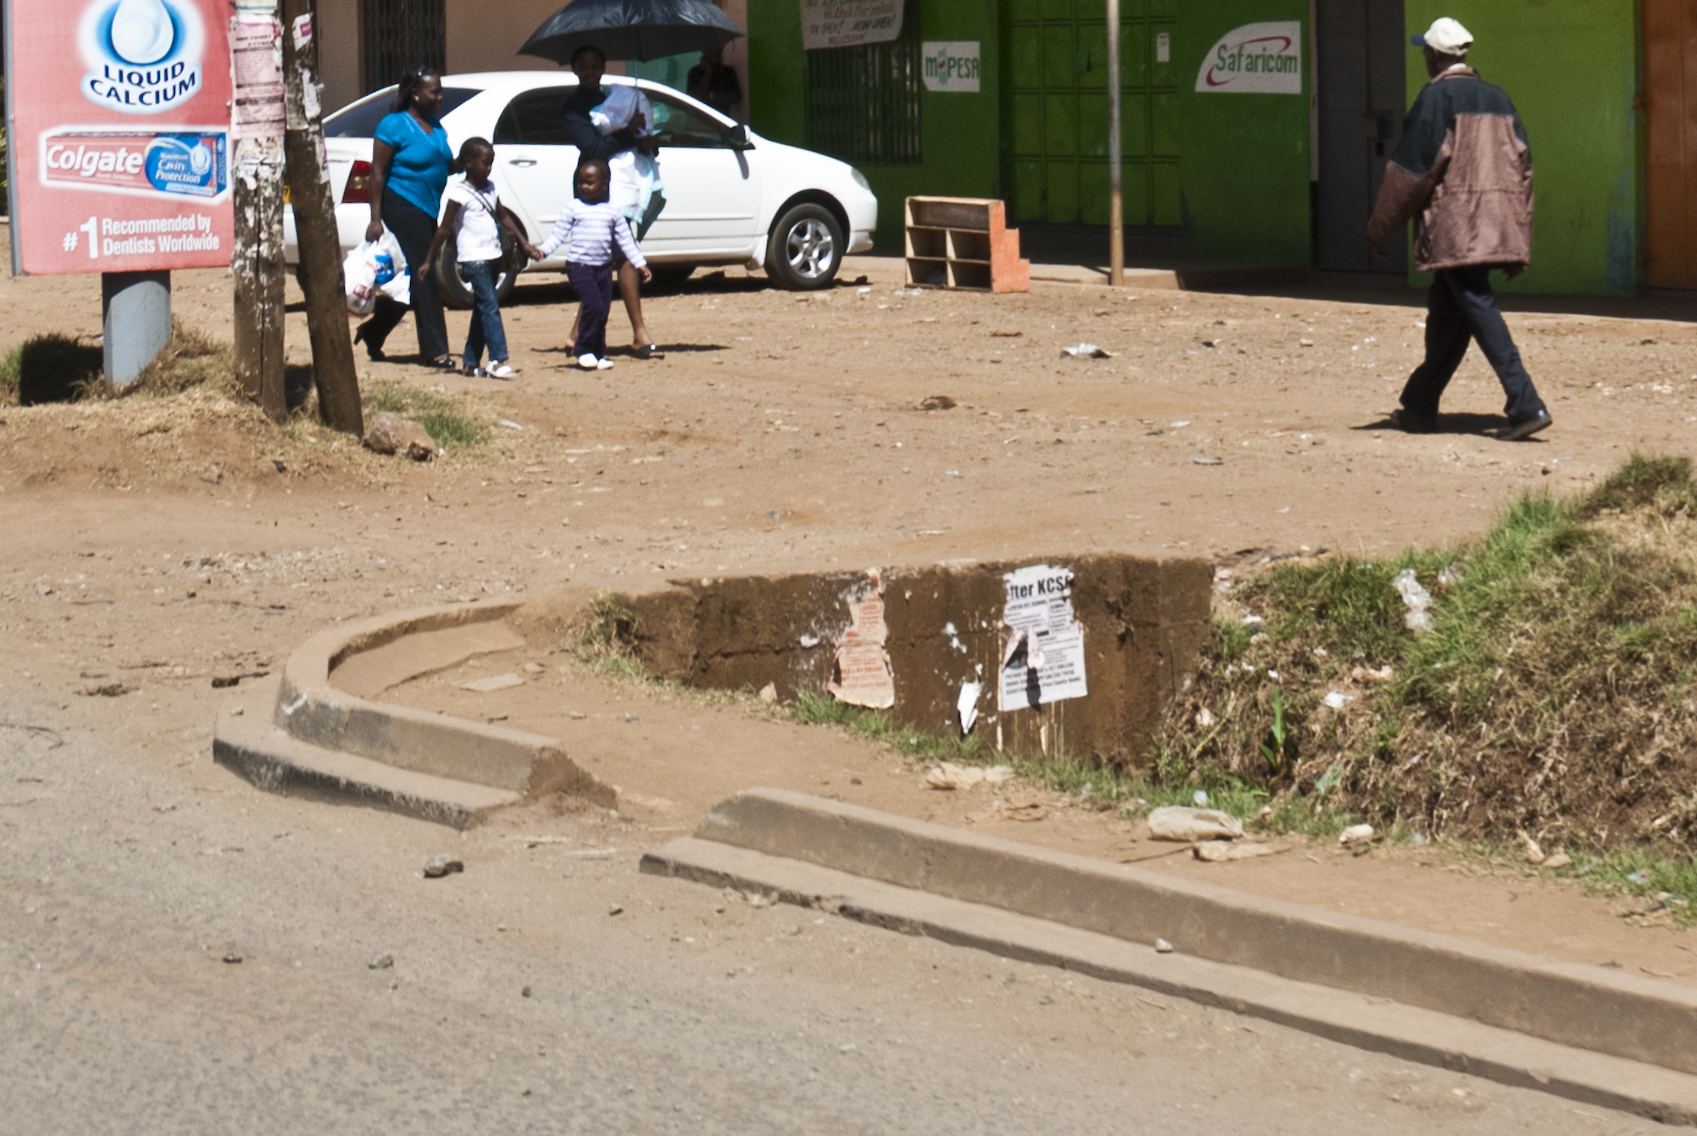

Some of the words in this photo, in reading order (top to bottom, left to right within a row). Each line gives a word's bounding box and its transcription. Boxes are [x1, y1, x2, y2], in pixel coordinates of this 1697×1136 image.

[1215, 44, 1297, 72] Safaricom
[104, 62, 186, 87] LIQUID
[90, 70, 197, 106] CALCIUM
[47, 145, 144, 177] Colgate
[158, 160, 186, 172] Cavity
[155, 169, 201, 184] Protection
[102, 216, 195, 237] Recommended
[198, 215, 212, 235] by
[103, 235, 156, 257] Dentists
[158, 230, 220, 253] Worldwide
